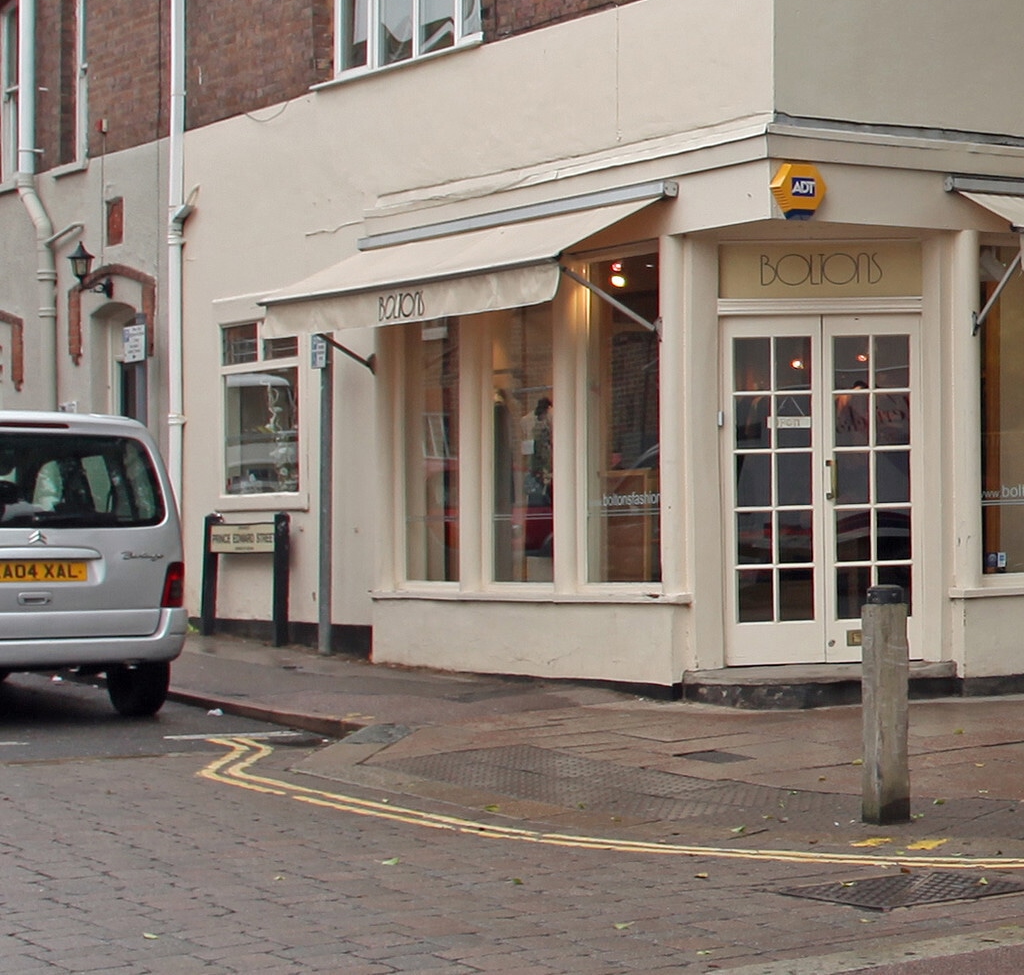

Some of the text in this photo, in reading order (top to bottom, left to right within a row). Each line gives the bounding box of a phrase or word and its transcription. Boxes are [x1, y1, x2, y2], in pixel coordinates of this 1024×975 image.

[792, 180, 815, 194] ADT
[760, 252, 883, 286] BOLTONS
[378, 290, 425, 322] BOLTONS
[212, 534, 231, 544] PRINCE
[232, 533, 254, 543] EDWARD
[0, 564, 78, 579] A04 XAL
